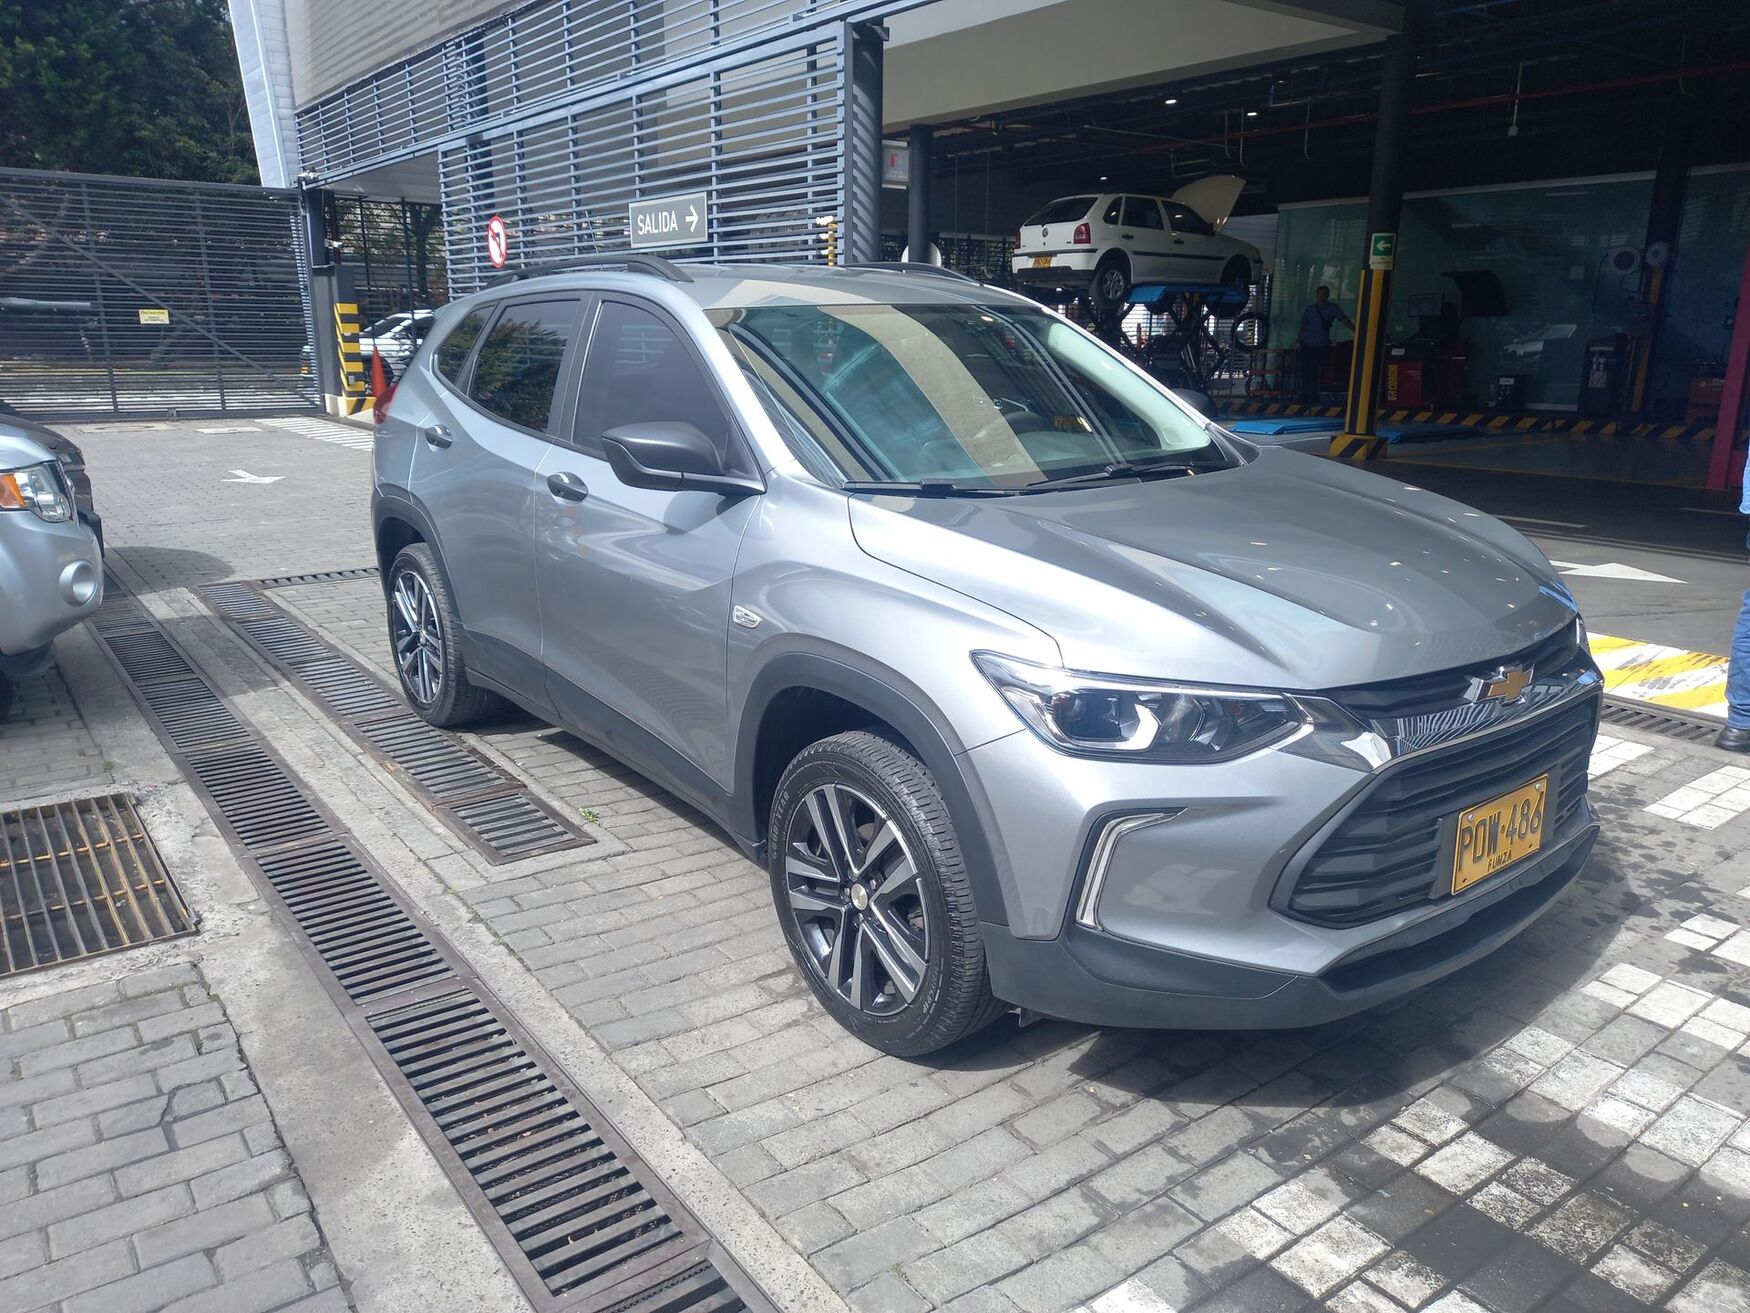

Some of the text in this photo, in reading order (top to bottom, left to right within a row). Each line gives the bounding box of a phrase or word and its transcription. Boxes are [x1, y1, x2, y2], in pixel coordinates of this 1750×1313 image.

[638, 211, 678, 235] SALIDA
[771, 791, 790, 860] GOODYEAR
[1488, 850, 1512, 872] FUNZA
